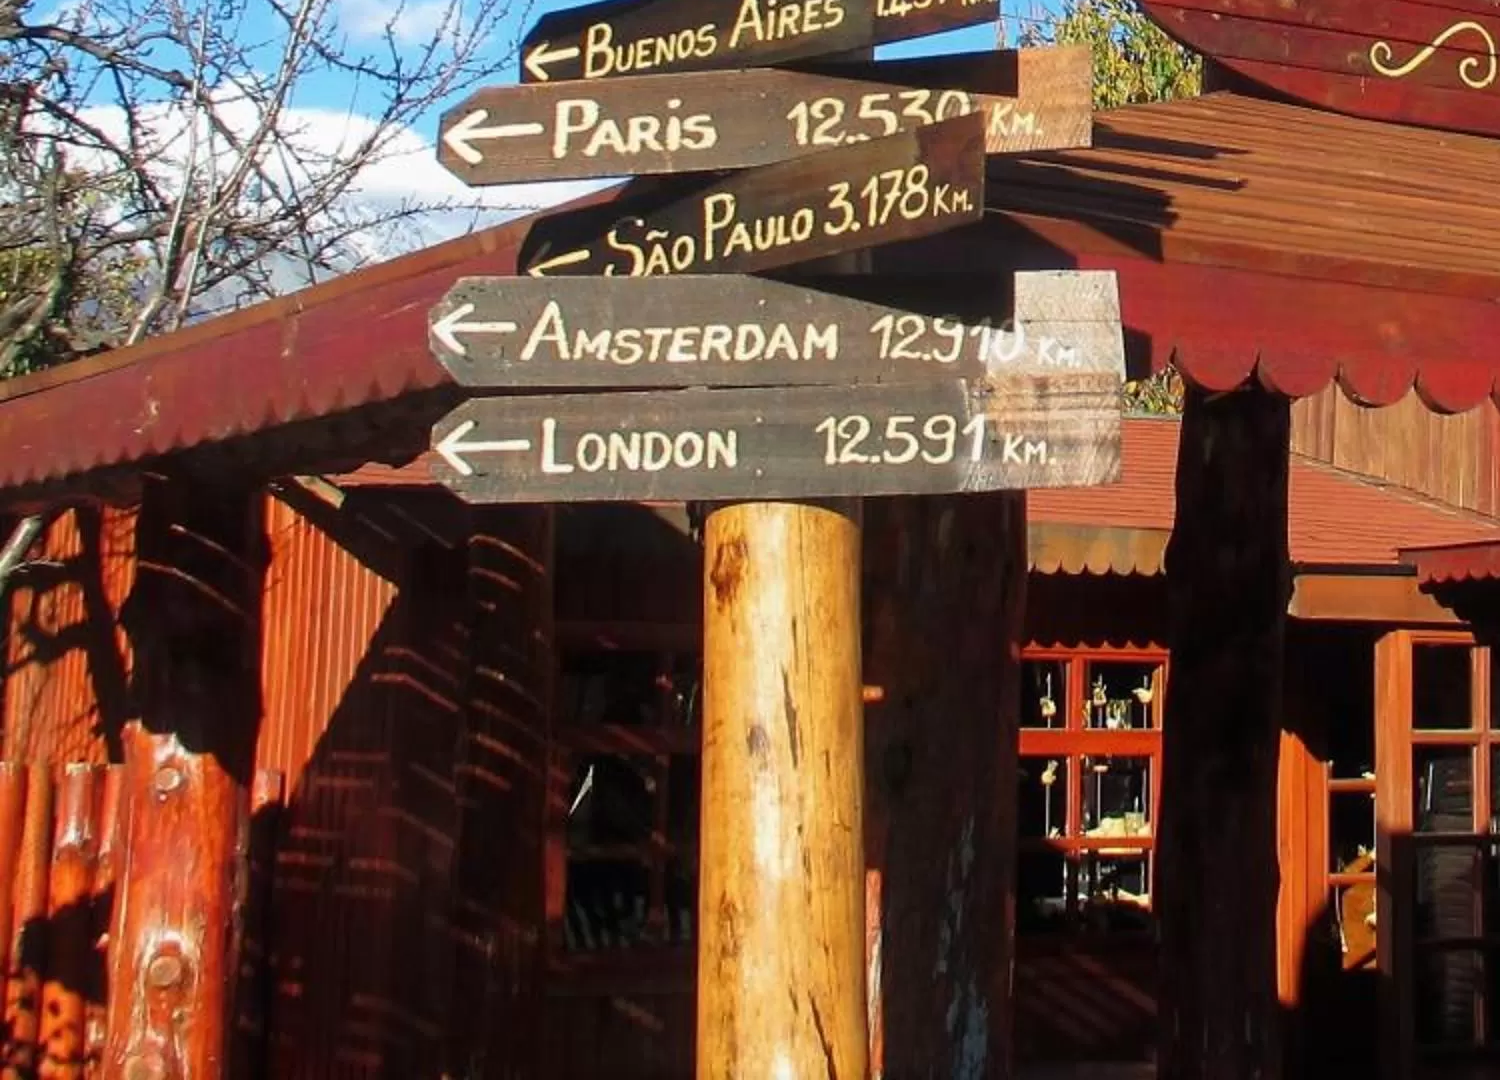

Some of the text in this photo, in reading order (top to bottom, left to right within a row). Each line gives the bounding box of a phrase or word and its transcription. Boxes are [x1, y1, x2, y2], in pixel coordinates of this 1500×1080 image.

[584, 23, 718, 79] BUENOS
[552, 98, 718, 159] PARIS
[703, 192, 814, 261] PAULO
[823, 165, 929, 236] 3.178
[520, 299, 839, 363] AMSTERDAM
[869, 314, 1026, 363] 12.910
[542, 418, 738, 475] LONDON
[814, 414, 987, 464] 12.591
